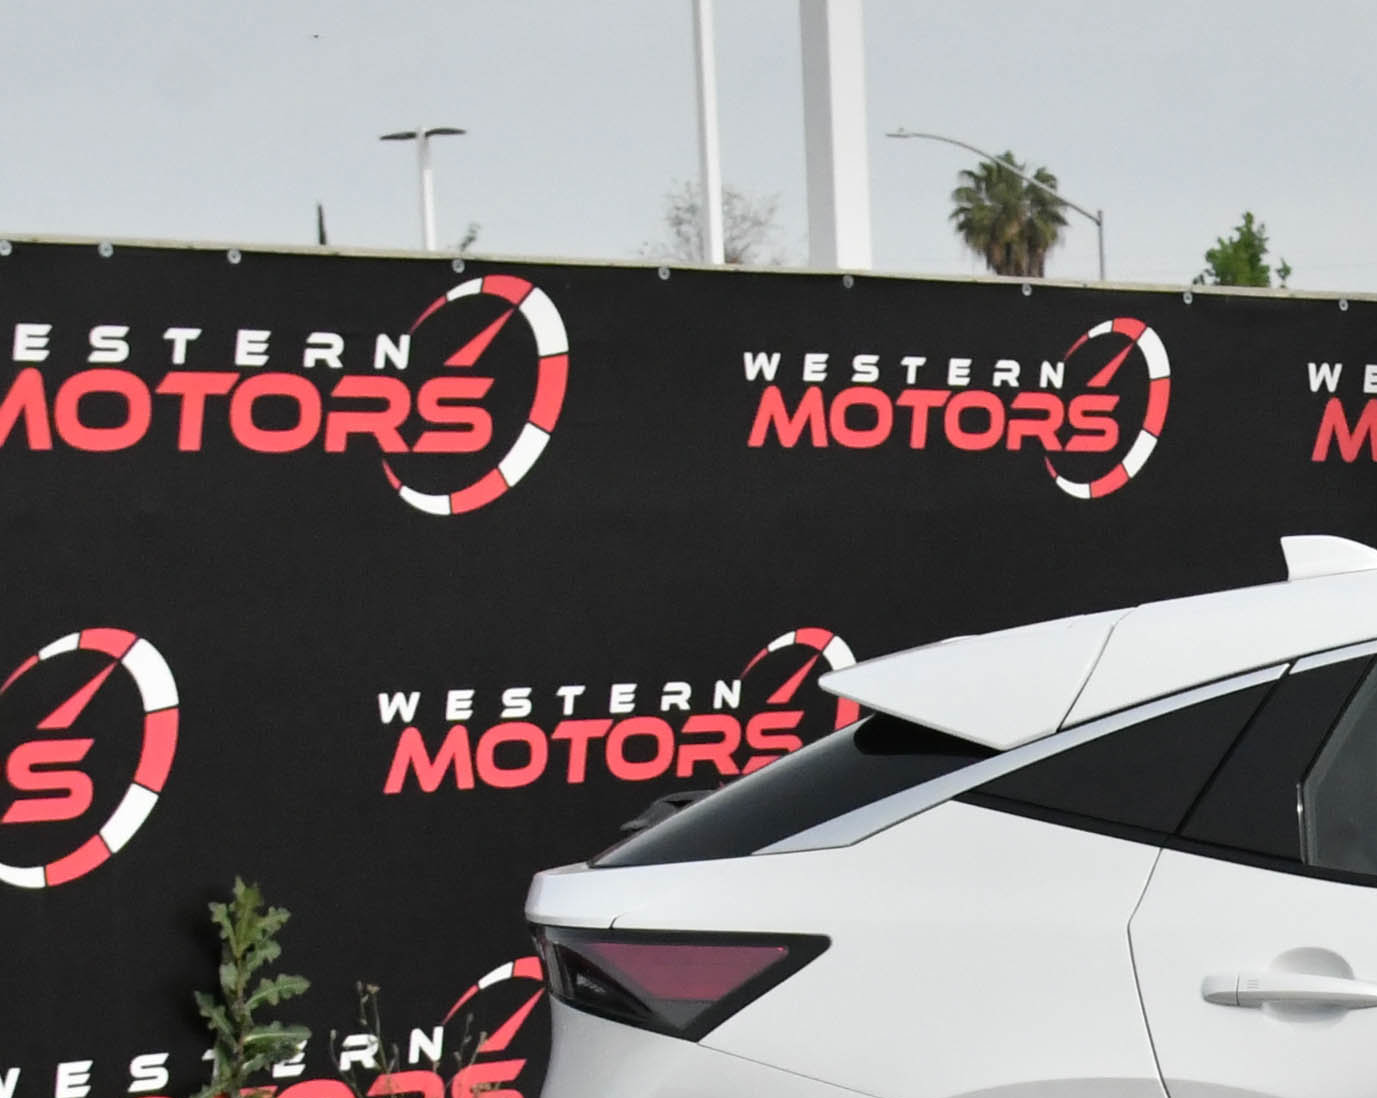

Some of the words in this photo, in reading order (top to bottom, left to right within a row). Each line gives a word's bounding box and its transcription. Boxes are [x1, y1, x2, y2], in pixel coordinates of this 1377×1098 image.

[743, 351, 1065, 389] WESTERN
[747, 385, 1120, 453] MOTORS
[378, 679, 742, 724] WESTERN
[383, 710, 804, 795] MOTORS
